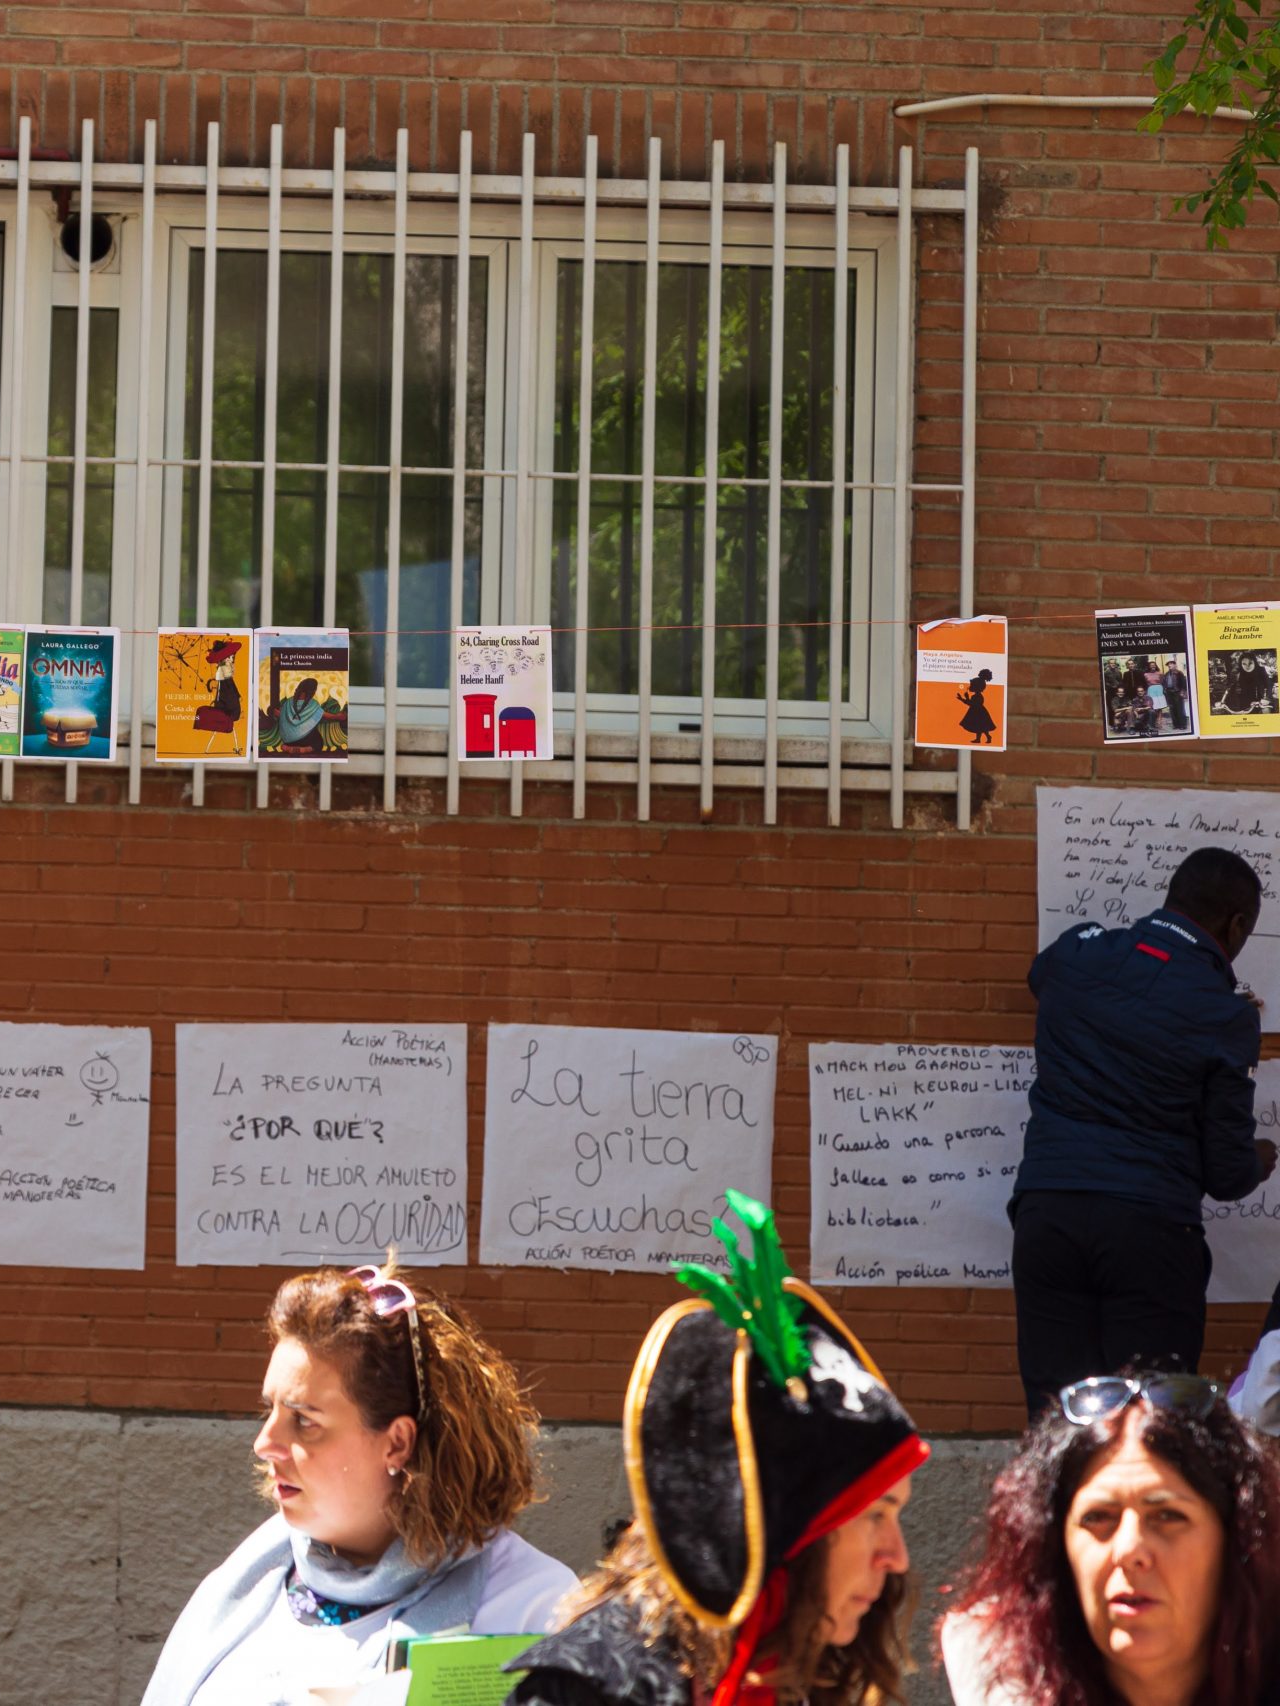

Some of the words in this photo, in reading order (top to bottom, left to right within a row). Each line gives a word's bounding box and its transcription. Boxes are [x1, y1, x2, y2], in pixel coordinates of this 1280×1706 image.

[473, 637, 500, 647] Charing
[502, 637, 520, 646] Cross
[522, 636, 540, 646] Road
[33, 658, 105, 677] OMNIA
[460, 675, 483, 685] Helene
[485, 675, 504, 685] Hanff
[1165, 812, 1181, 830] de
[1248, 819, 1269, 838] de
[1065, 831, 1112, 847] nombre
[1089, 853, 1129, 866] mucho
[260, 1074, 382, 1096] PREGUNTA
[510, 1039, 600, 1117] La
[618, 1049, 758, 1128] tierra
[904, 1137, 933, 1148] una
[944, 1124, 1006, 1150] persona
[574, 1124, 698, 1188] grita
[212, 1164, 246, 1186] ES
[260, 1166, 291, 1186] EL
[306, 1157, 368, 1188] MEJOR
[376, 1167, 457, 1188] AMULETO
[830, 1166, 888, 1187] fallece
[929, 1171, 966, 1183] como
[2, 1190, 82, 1203] MANOTERAS
[197, 1209, 281, 1236] CONTRA
[299, 1210, 330, 1234] LA
[335, 1194, 466, 1251] OSCURIDAD
[835, 1256, 885, 1279] Acción
[896, 1262, 952, 1286] poética
